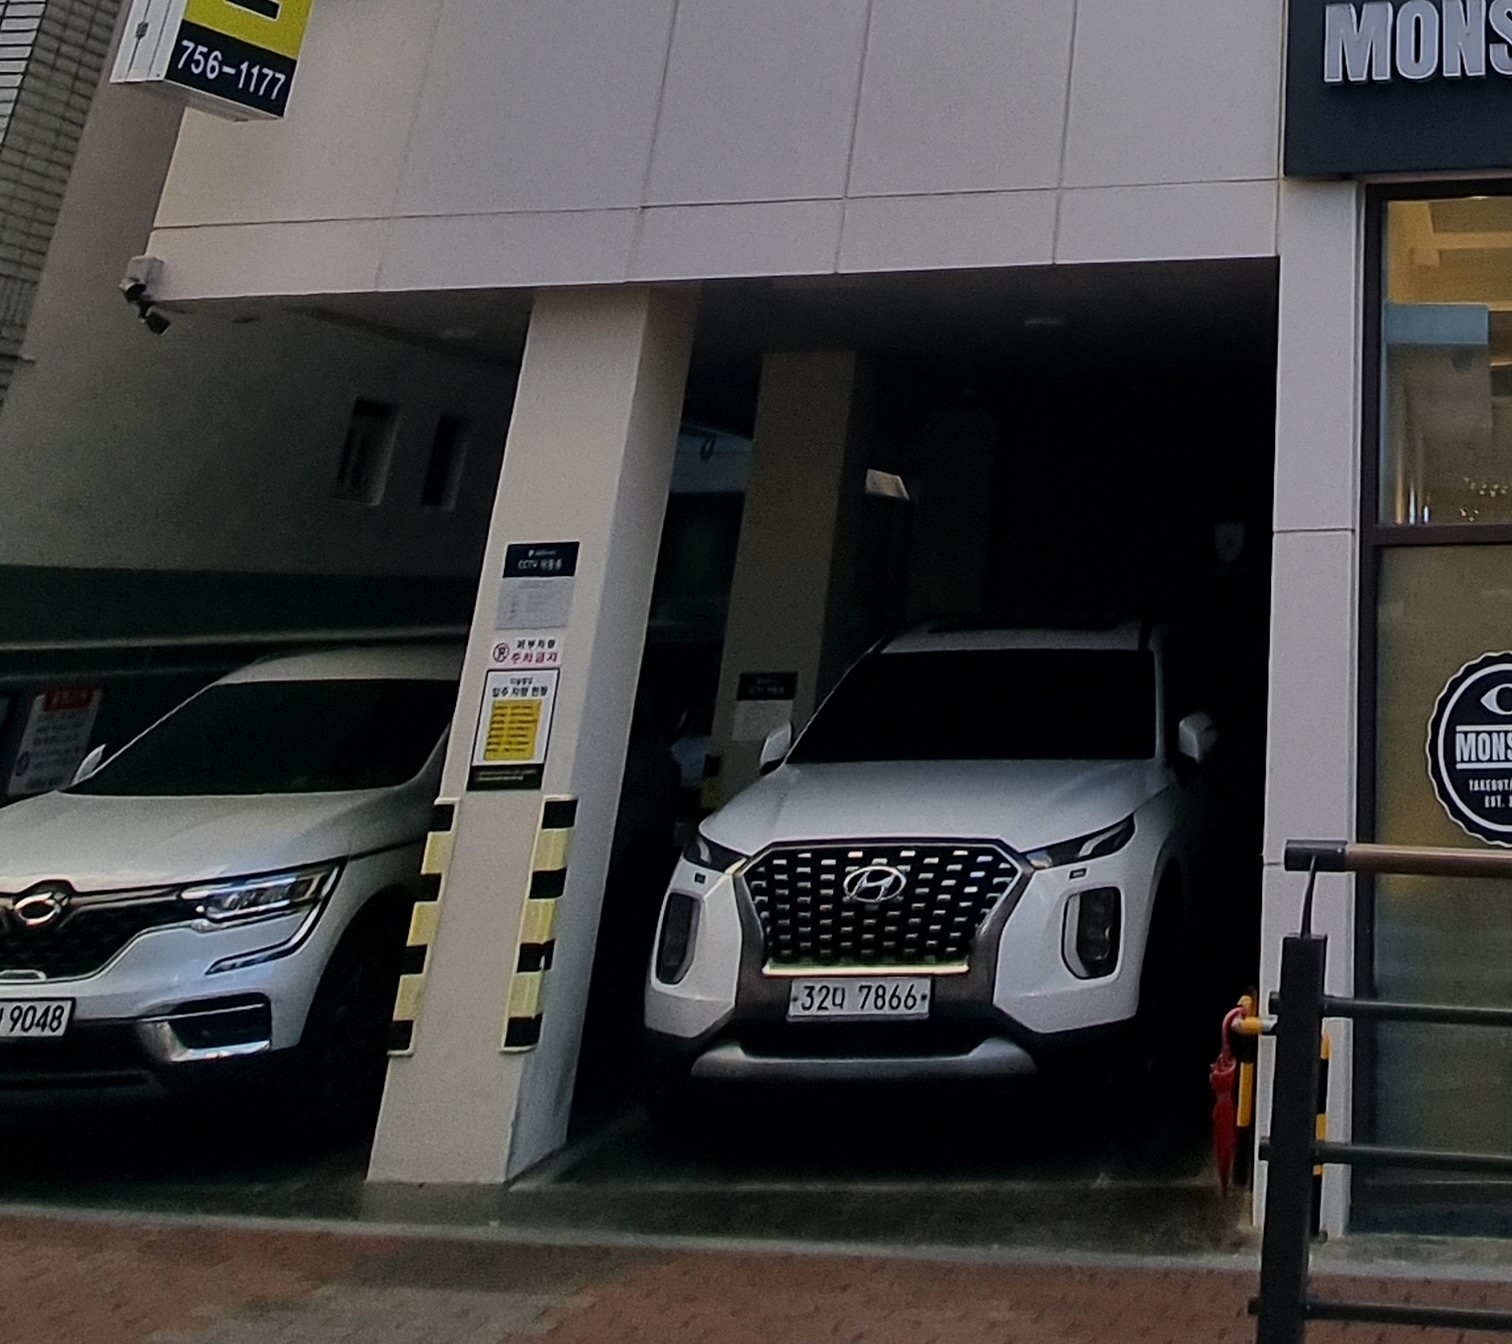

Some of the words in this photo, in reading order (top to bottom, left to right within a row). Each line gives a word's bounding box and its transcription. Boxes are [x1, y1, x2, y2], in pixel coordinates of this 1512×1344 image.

[176, 39, 287, 102] 756-1177
[1484, 794, 1506, 809] EST.
[858, 983, 917, 1011] 7866
[9, 1004, 65, 1033] 9048
